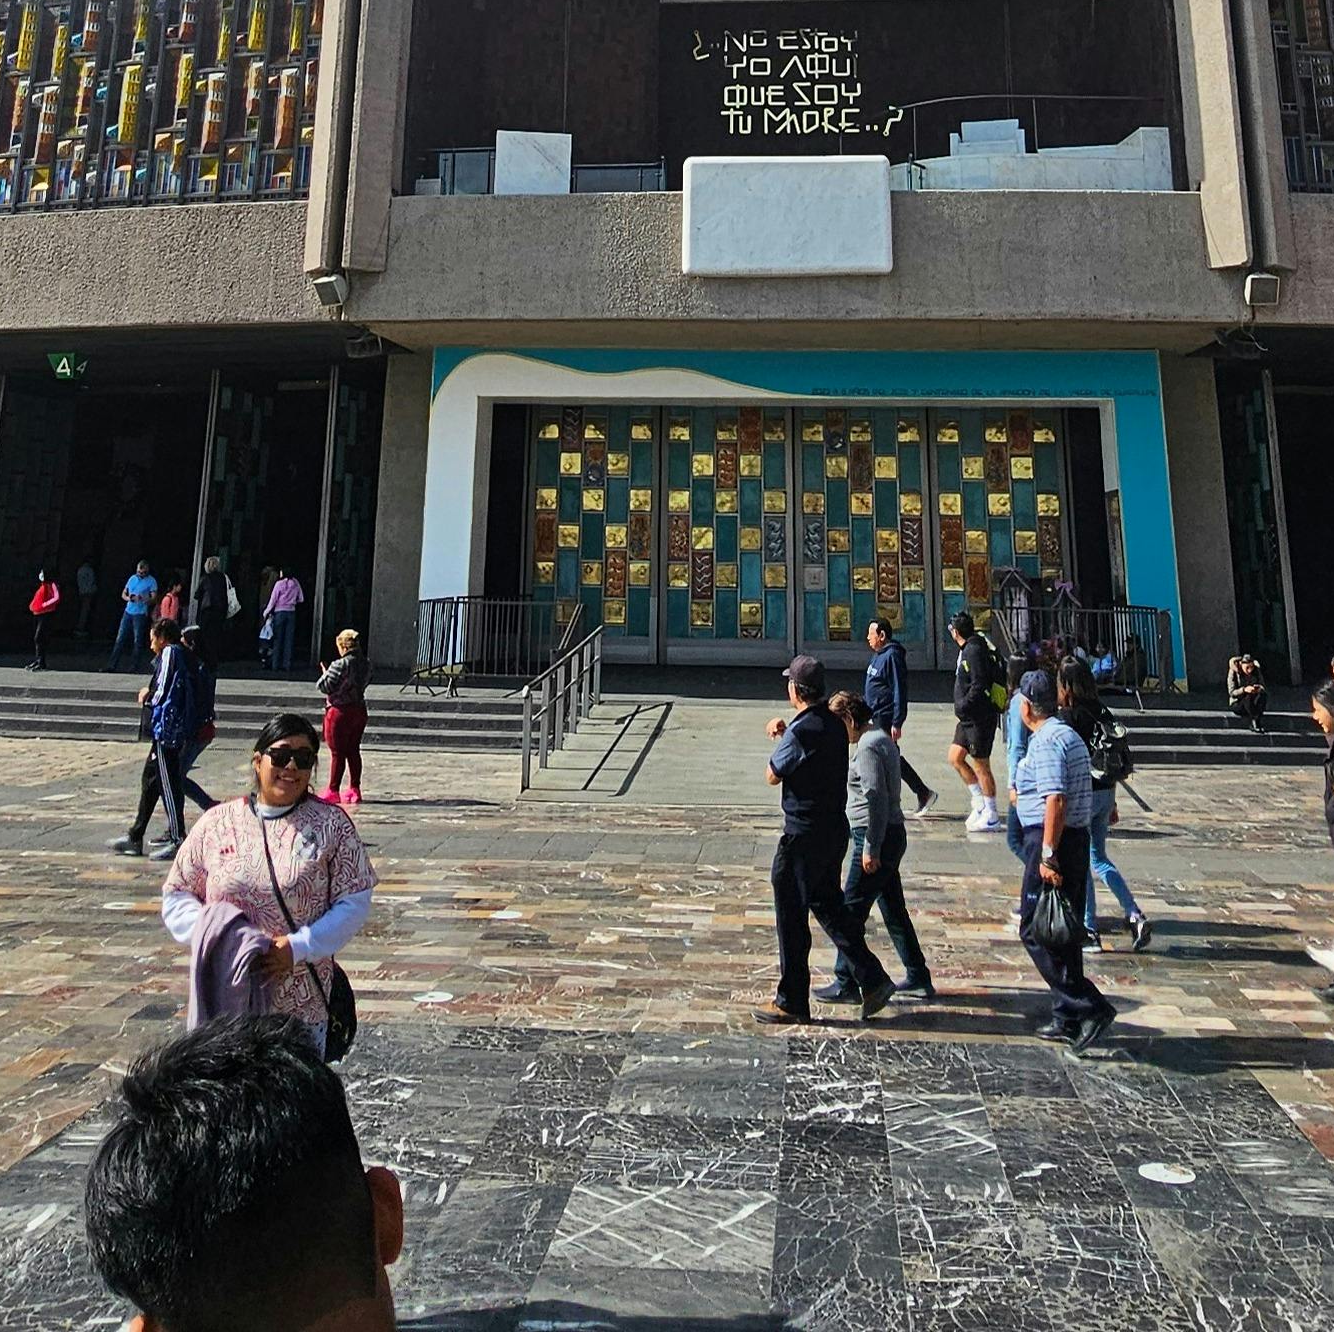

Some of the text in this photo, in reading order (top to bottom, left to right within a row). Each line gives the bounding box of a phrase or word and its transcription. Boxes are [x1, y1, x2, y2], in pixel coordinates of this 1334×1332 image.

[776, 28, 858, 52] ESTOY
[724, 55, 771, 80] YO
[723, 82, 862, 109] QUE SOY
[720, 107, 752, 135] TU
[56, 356, 71, 376] 4
